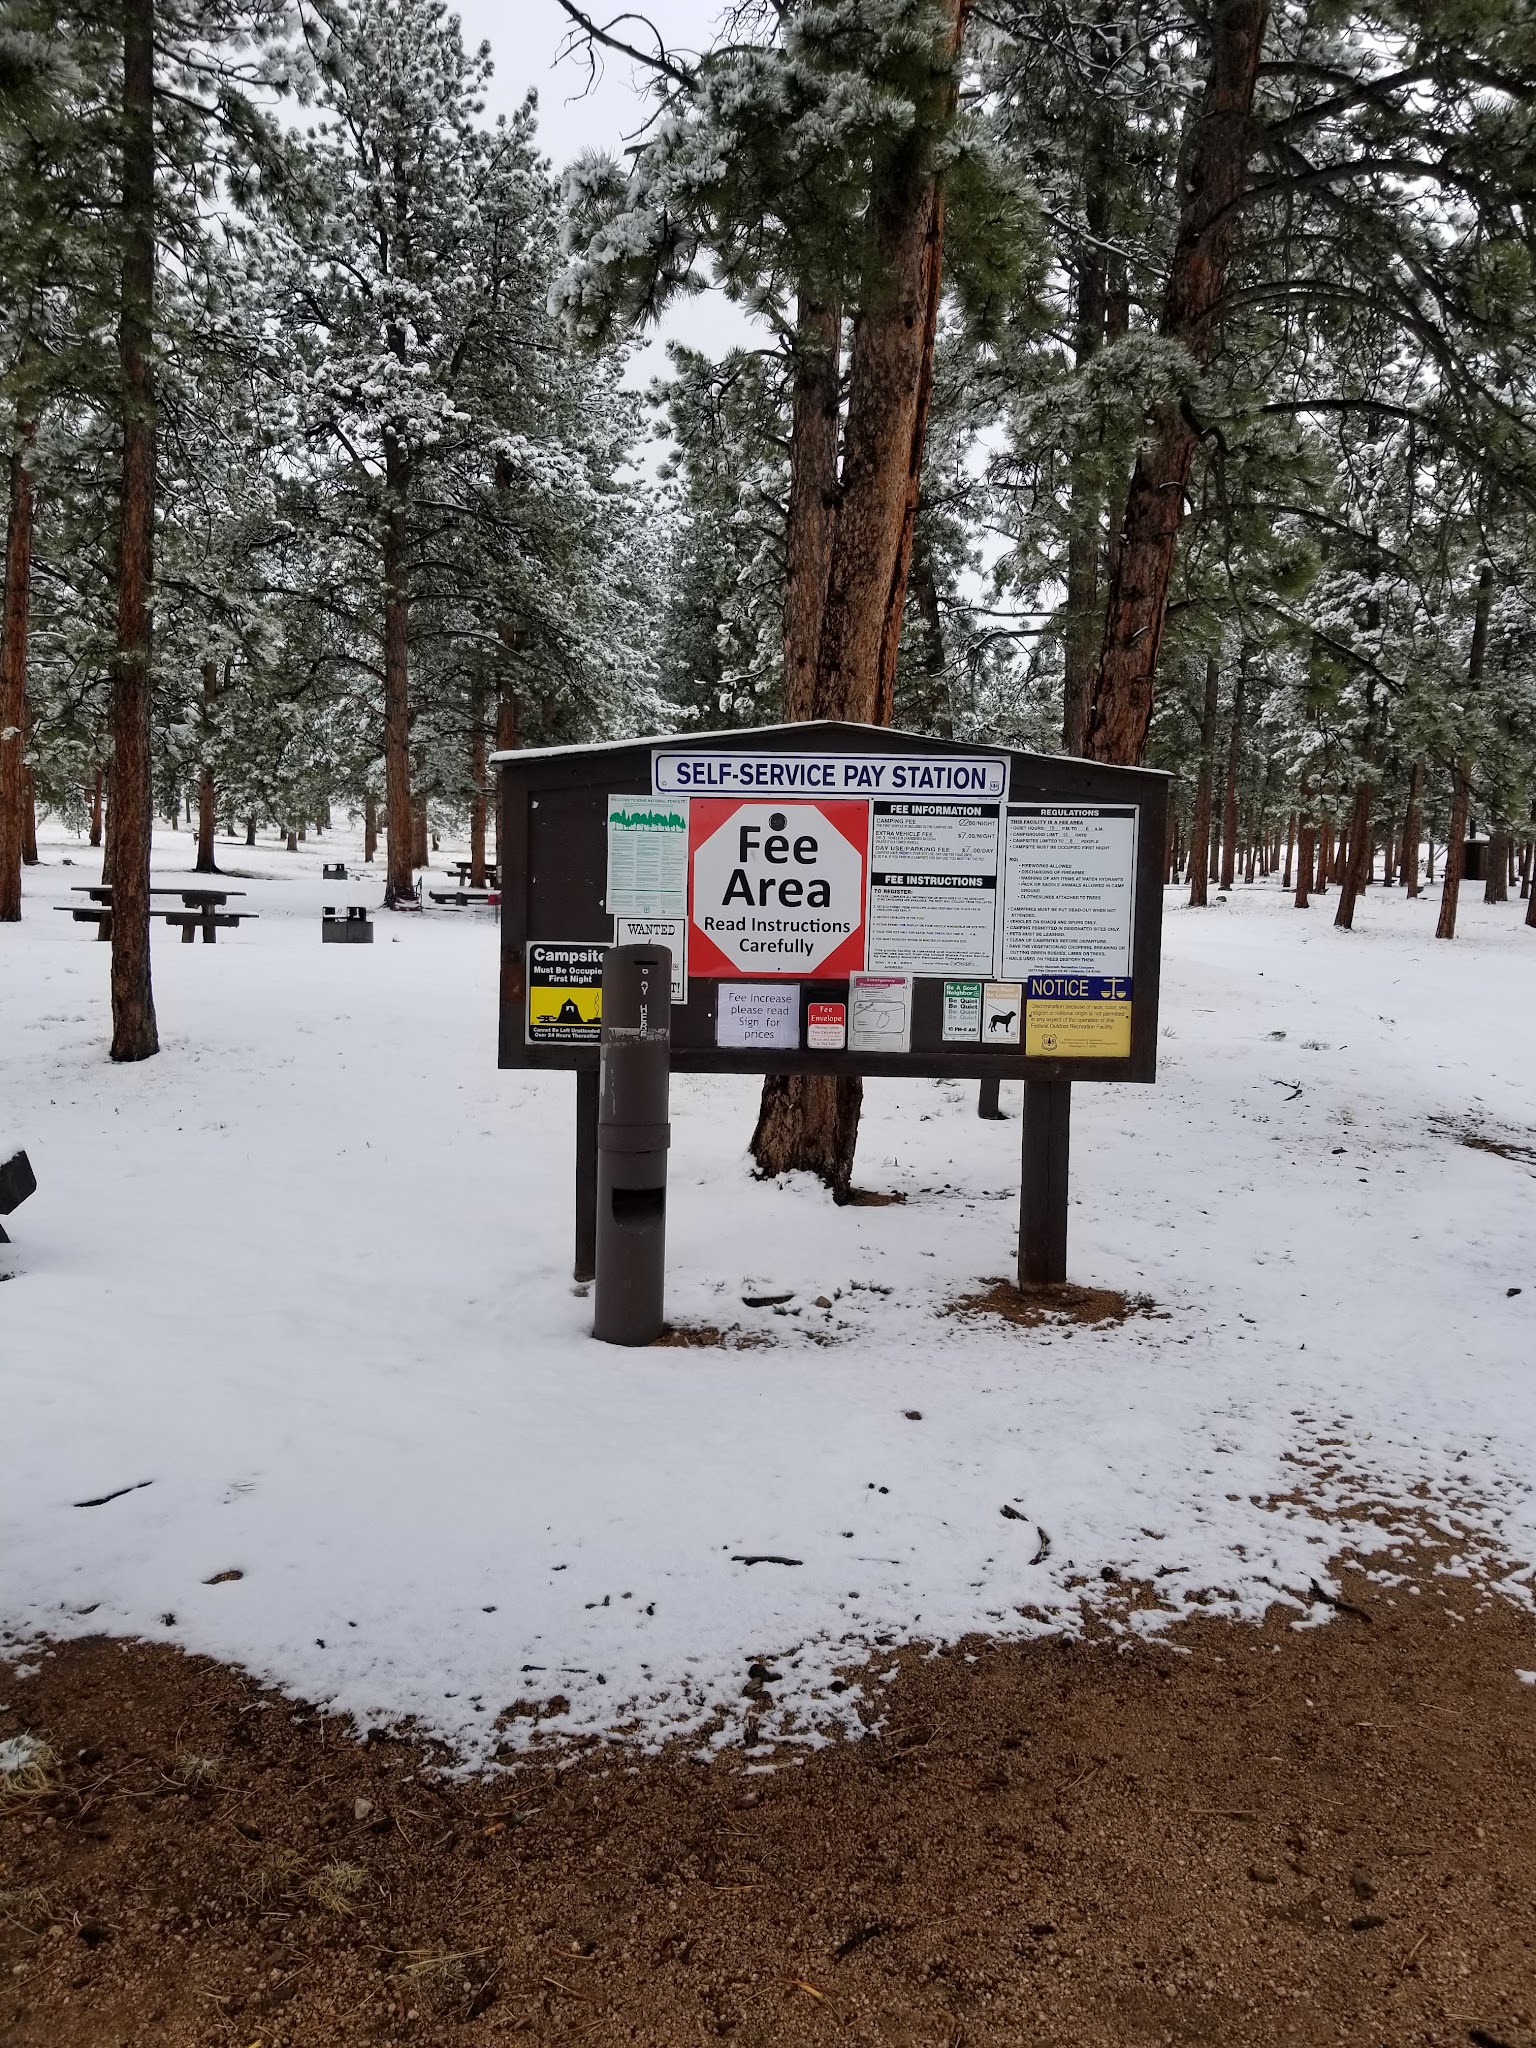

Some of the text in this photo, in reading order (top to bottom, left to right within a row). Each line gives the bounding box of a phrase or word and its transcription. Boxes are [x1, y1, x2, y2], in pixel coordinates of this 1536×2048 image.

[676, 762, 986, 789] SELF-SERVICE PAY STATION
[890, 805, 981, 816] FEE INFORMATION
[739, 826, 818, 864] Fee
[885, 876, 983, 886] FEE INSTRUCTIONS
[722, 869, 831, 908] Area
[628, 924, 675, 935] WANTED
[705, 917, 850, 933] Read Instructions
[740, 939, 814, 957] Carefully
[556, 966, 567, 974] Be
[569, 967, 602, 975] Occupie
[570, 975, 592, 984] Night
[1032, 979, 1089, 997] NOTICE
[729, 993, 747, 1002] Fee
[731, 1005, 789, 1015] please read
[739, 1017, 780, 1028] Sign for
[811, 1015, 842, 1023] Envelope
[744, 1029, 775, 1040] prices
